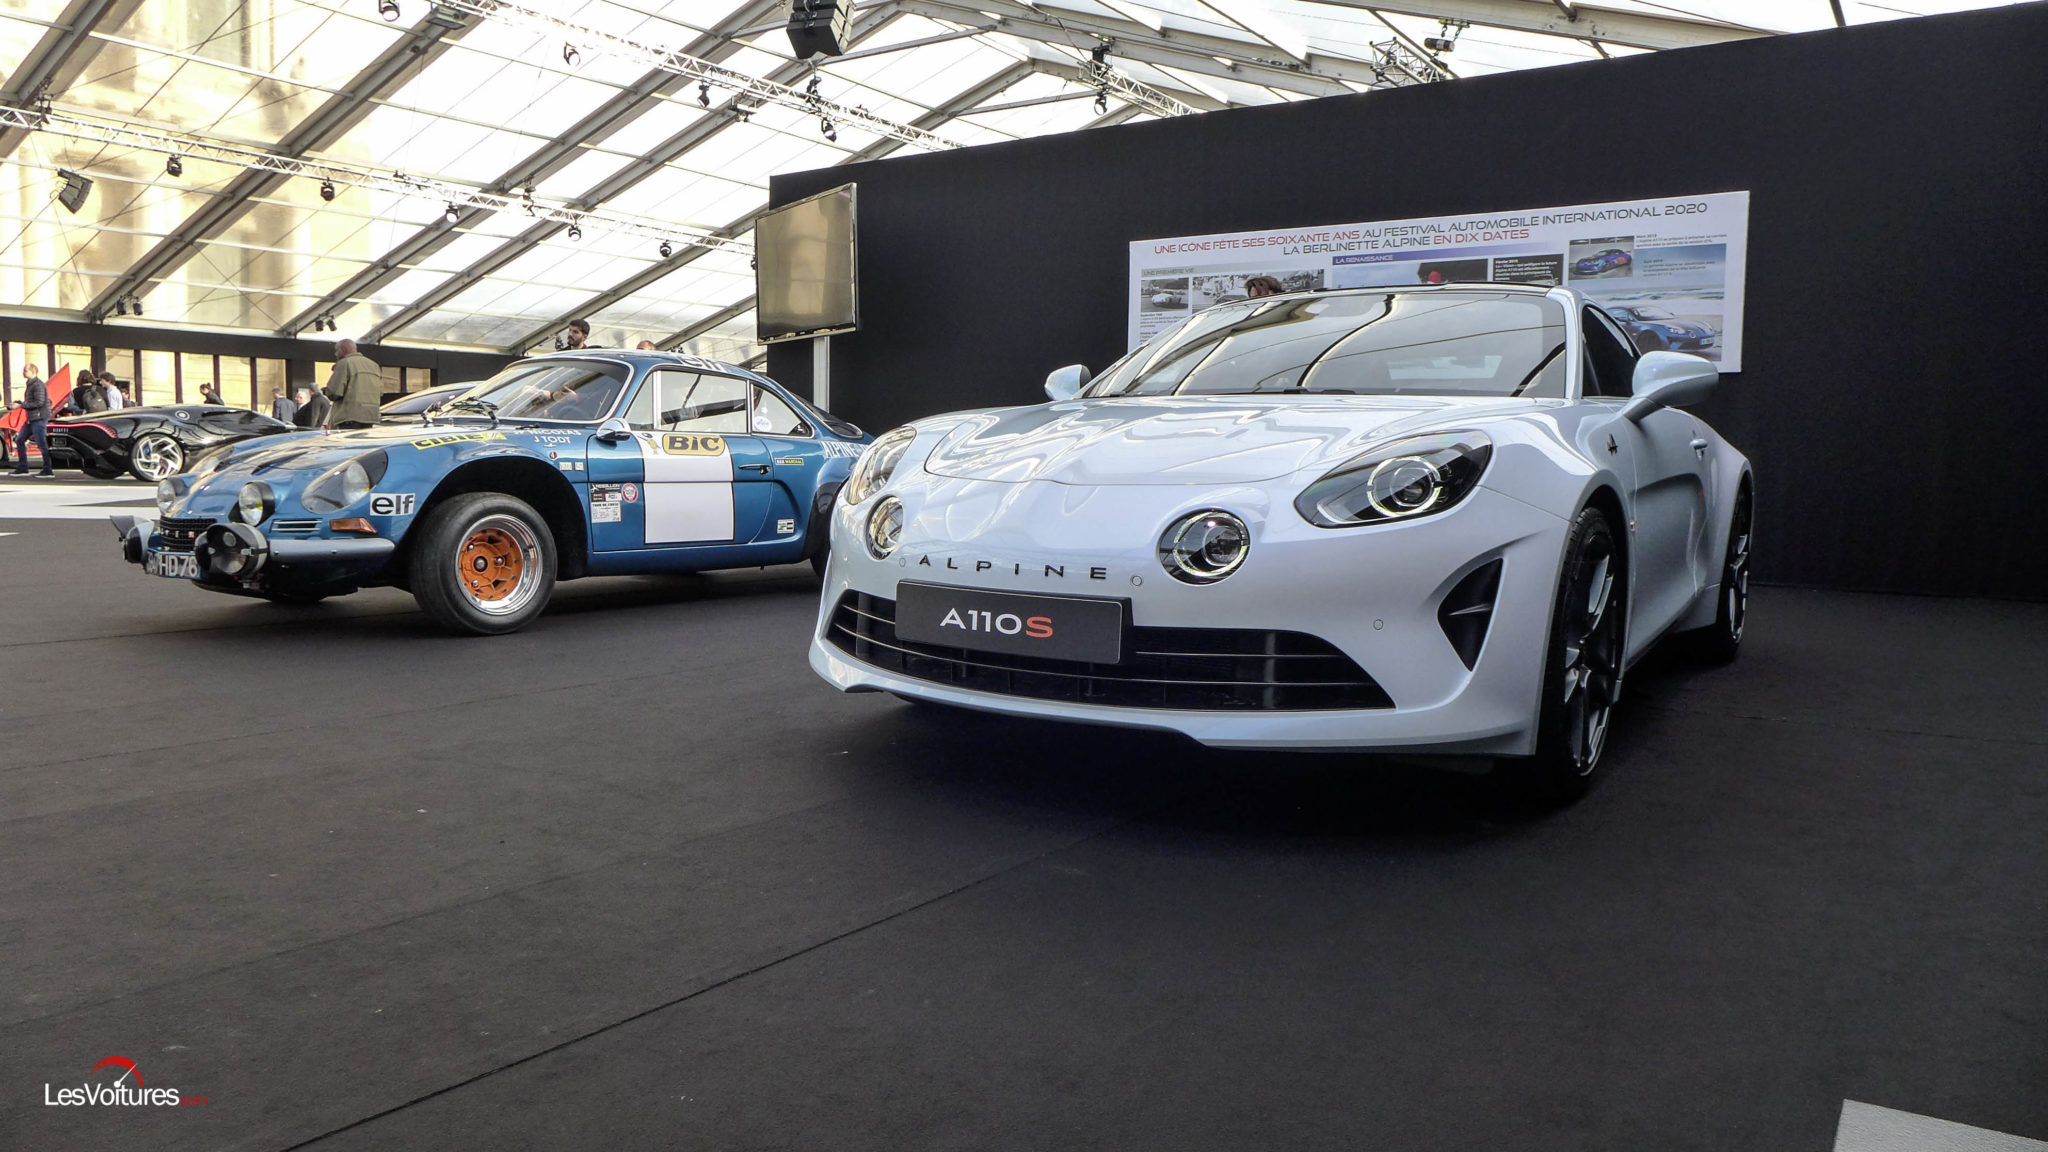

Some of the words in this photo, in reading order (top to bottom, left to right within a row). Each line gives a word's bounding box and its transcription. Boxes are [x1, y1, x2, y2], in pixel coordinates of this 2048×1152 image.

[1154, 244, 1176, 255] UNE
[1212, 238, 1241, 250] FÊTE
[1242, 237, 1266, 248] SES
[1267, 232, 1332, 246] SOIXANTE
[1333, 230, 1360, 242] ANS
[1363, 228, 1382, 239] AU
[1384, 223, 1445, 237] FESTIVAL
[1447, 216, 1540, 233] AUTOMOBILE
[1542, 205, 1661, 225] INTERNATIONAL
[1664, 202, 1708, 216] 2020
[1283, 245, 1300, 256] LA
[1302, 239, 1379, 254] BERLINETTE
[1381, 236, 1430, 249] ALPINE
[1433, 234, 1452, 245] EN
[1455, 232, 1484, 243] DIX
[1486, 228, 1529, 241] DATES
[541, 436, 572, 444] TODT
[371, 493, 414, 515] elf
[919, 554, 1107, 580] ALPINE
[939, 607, 1054, 638] A110S
